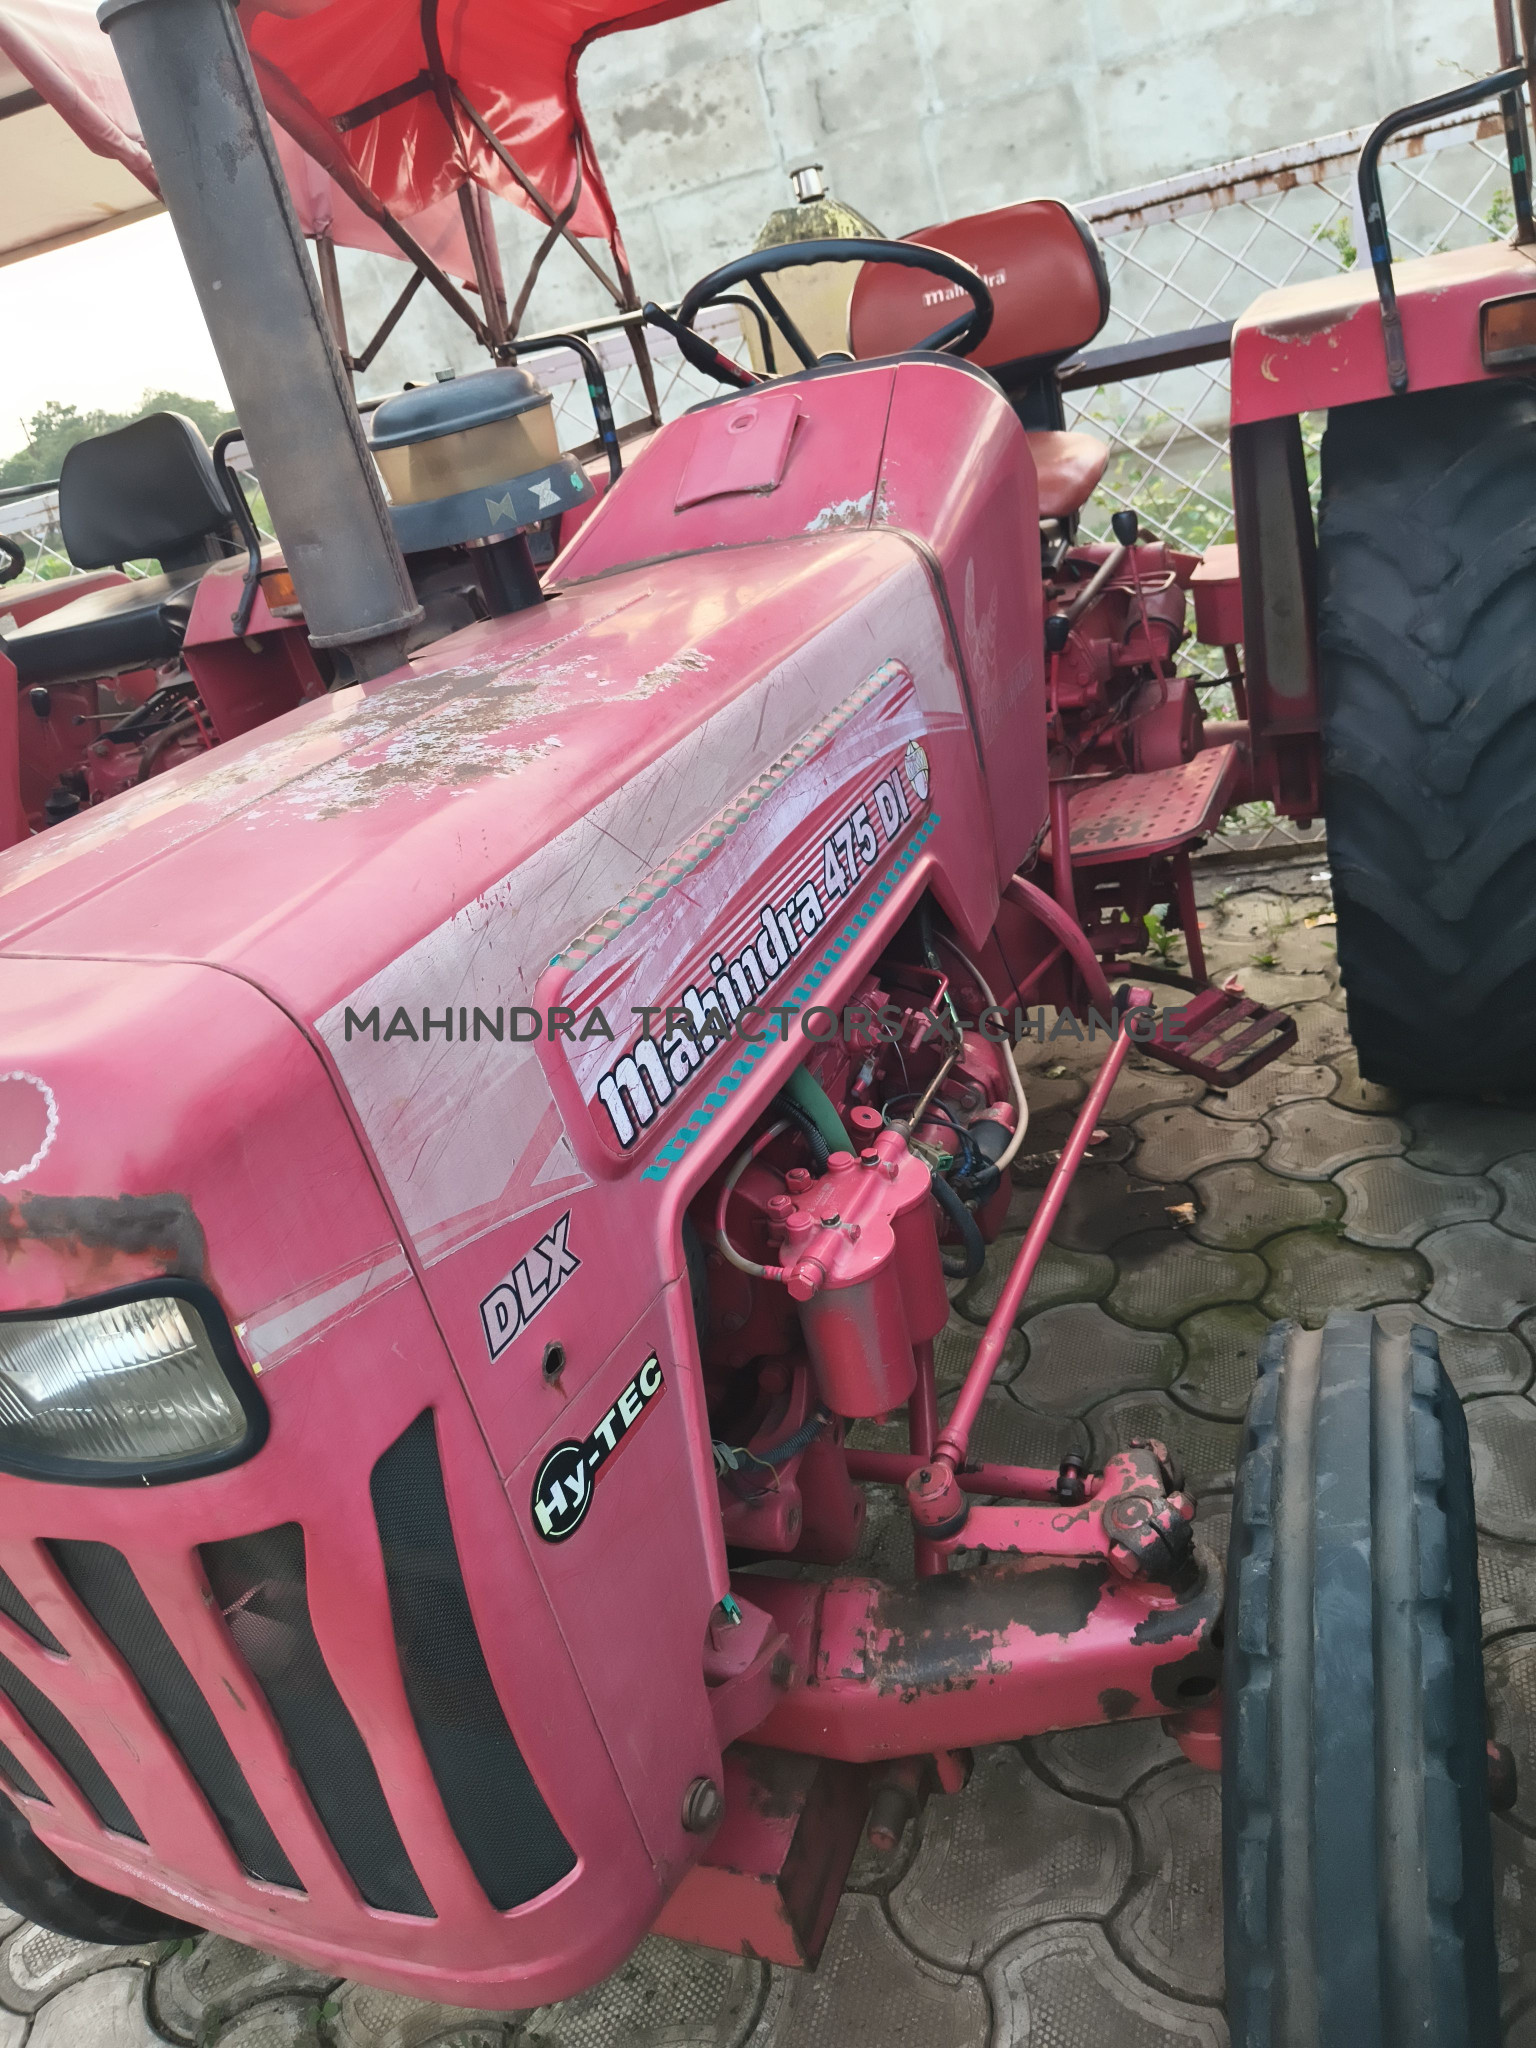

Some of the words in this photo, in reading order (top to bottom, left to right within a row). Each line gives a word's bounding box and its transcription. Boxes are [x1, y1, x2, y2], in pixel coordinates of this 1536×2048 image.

[823, 802, 879, 900] 475
[872, 767, 912, 842] DI
[480, 1209, 582, 1361] DLX
[534, 1357, 663, 1536] Hy-TEC
